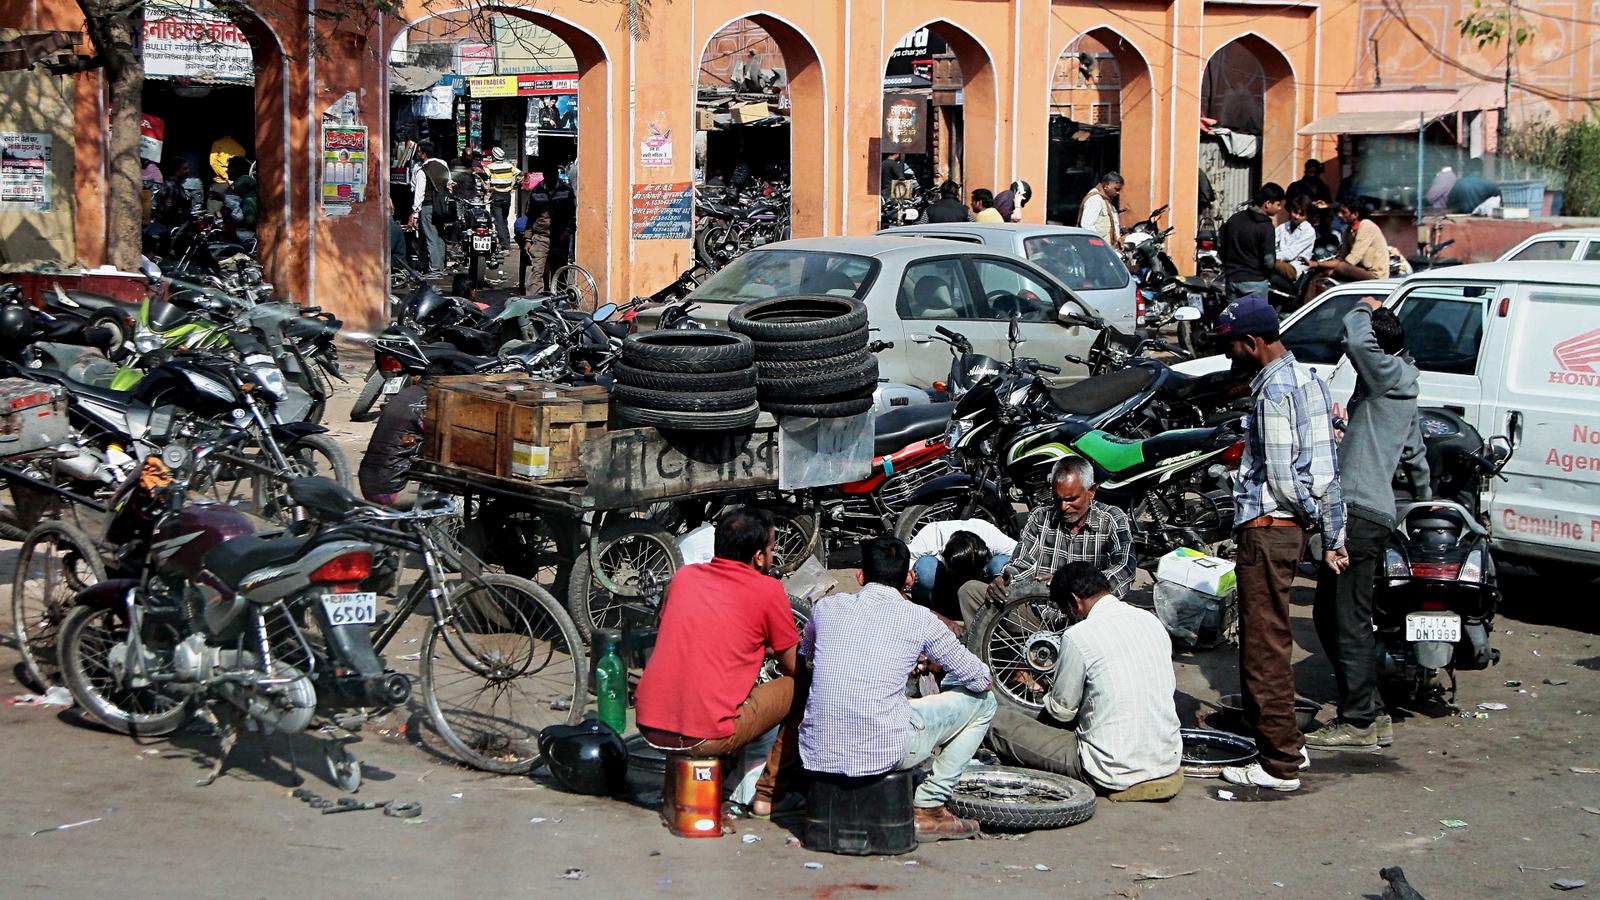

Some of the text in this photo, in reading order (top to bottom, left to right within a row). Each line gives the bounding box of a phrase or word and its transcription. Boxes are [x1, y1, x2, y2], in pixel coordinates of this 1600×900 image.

[145, 42, 172, 51] BULLET
[483, 78, 506, 86] TRADERS
[1503, 508, 1583, 540] Genuine
[333, 605, 373, 623] 6501
[1420, 617, 1447, 628] RJ14
[1416, 629, 1457, 640] DN1969
